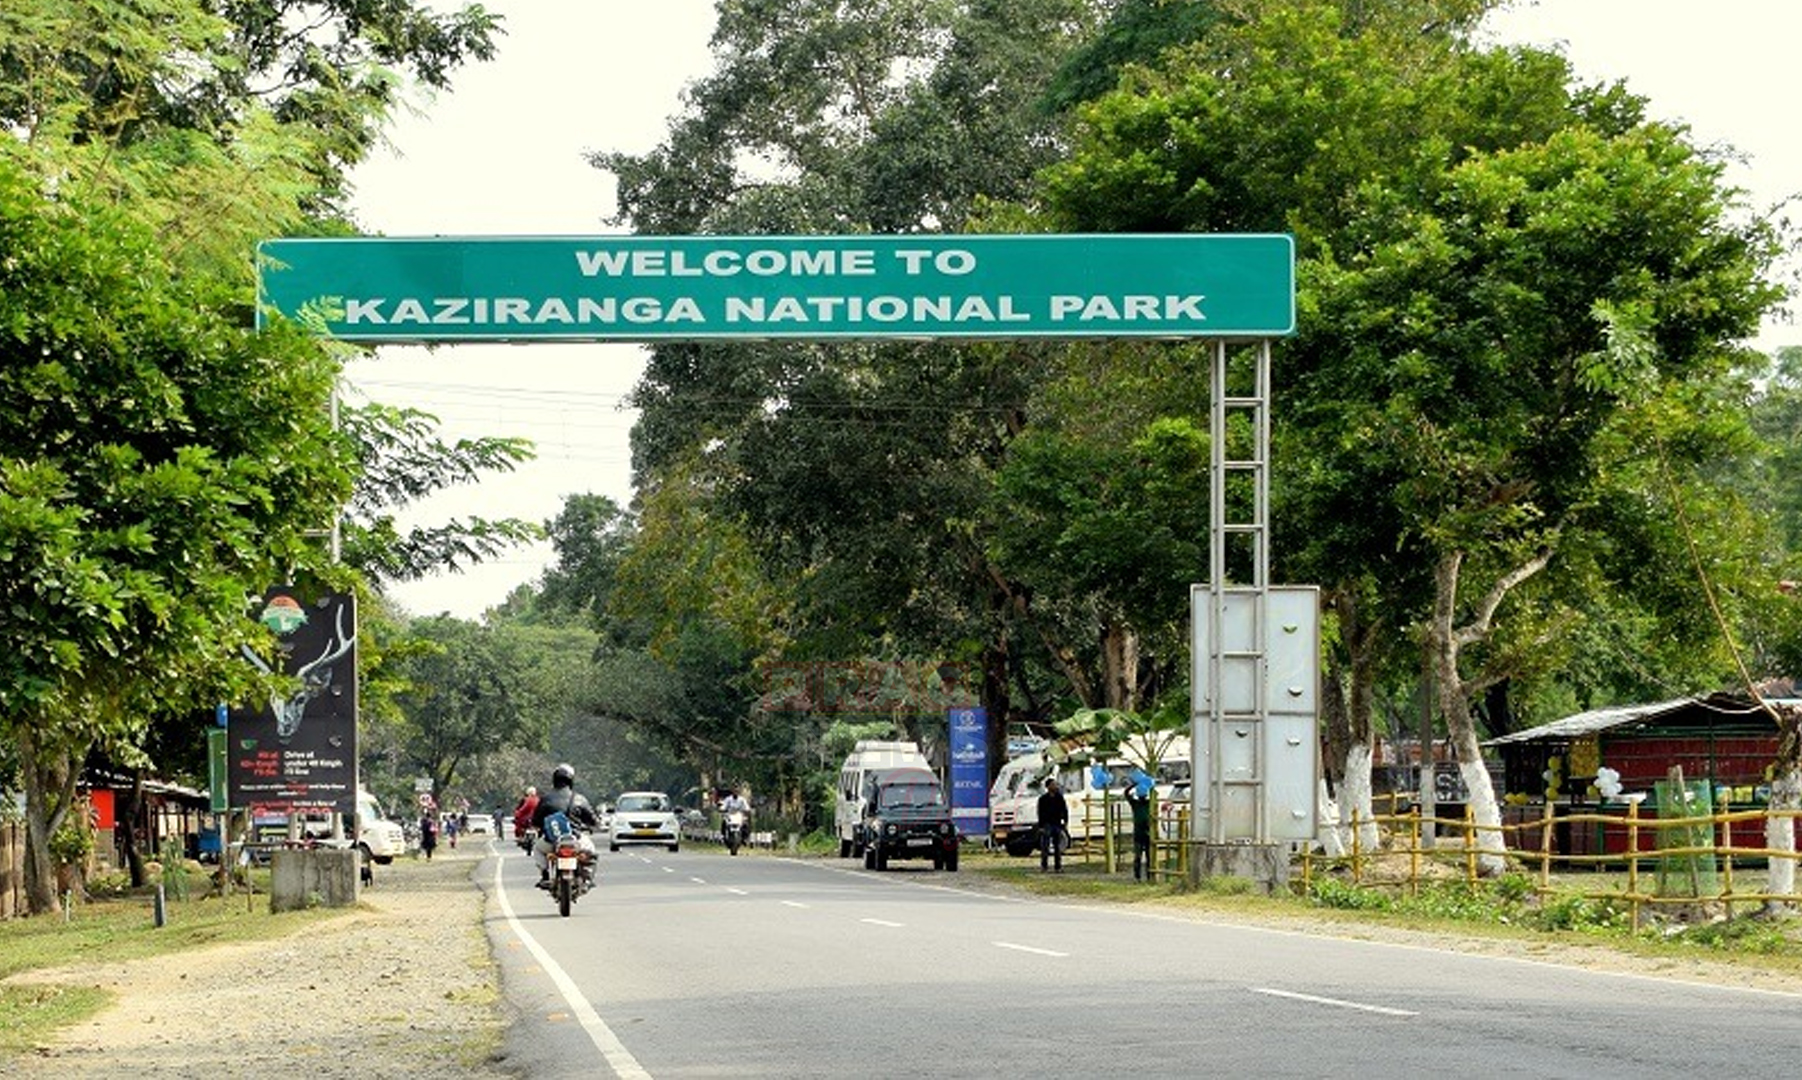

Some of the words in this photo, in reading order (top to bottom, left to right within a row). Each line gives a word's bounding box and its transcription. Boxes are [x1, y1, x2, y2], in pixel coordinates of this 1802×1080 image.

[576, 250, 875, 277] WELCOME
[896, 249, 976, 276] TO
[346, 297, 706, 324] KAZIRANGA
[725, 296, 1031, 323] NATIONAL
[1050, 295, 1206, 321] PARK
